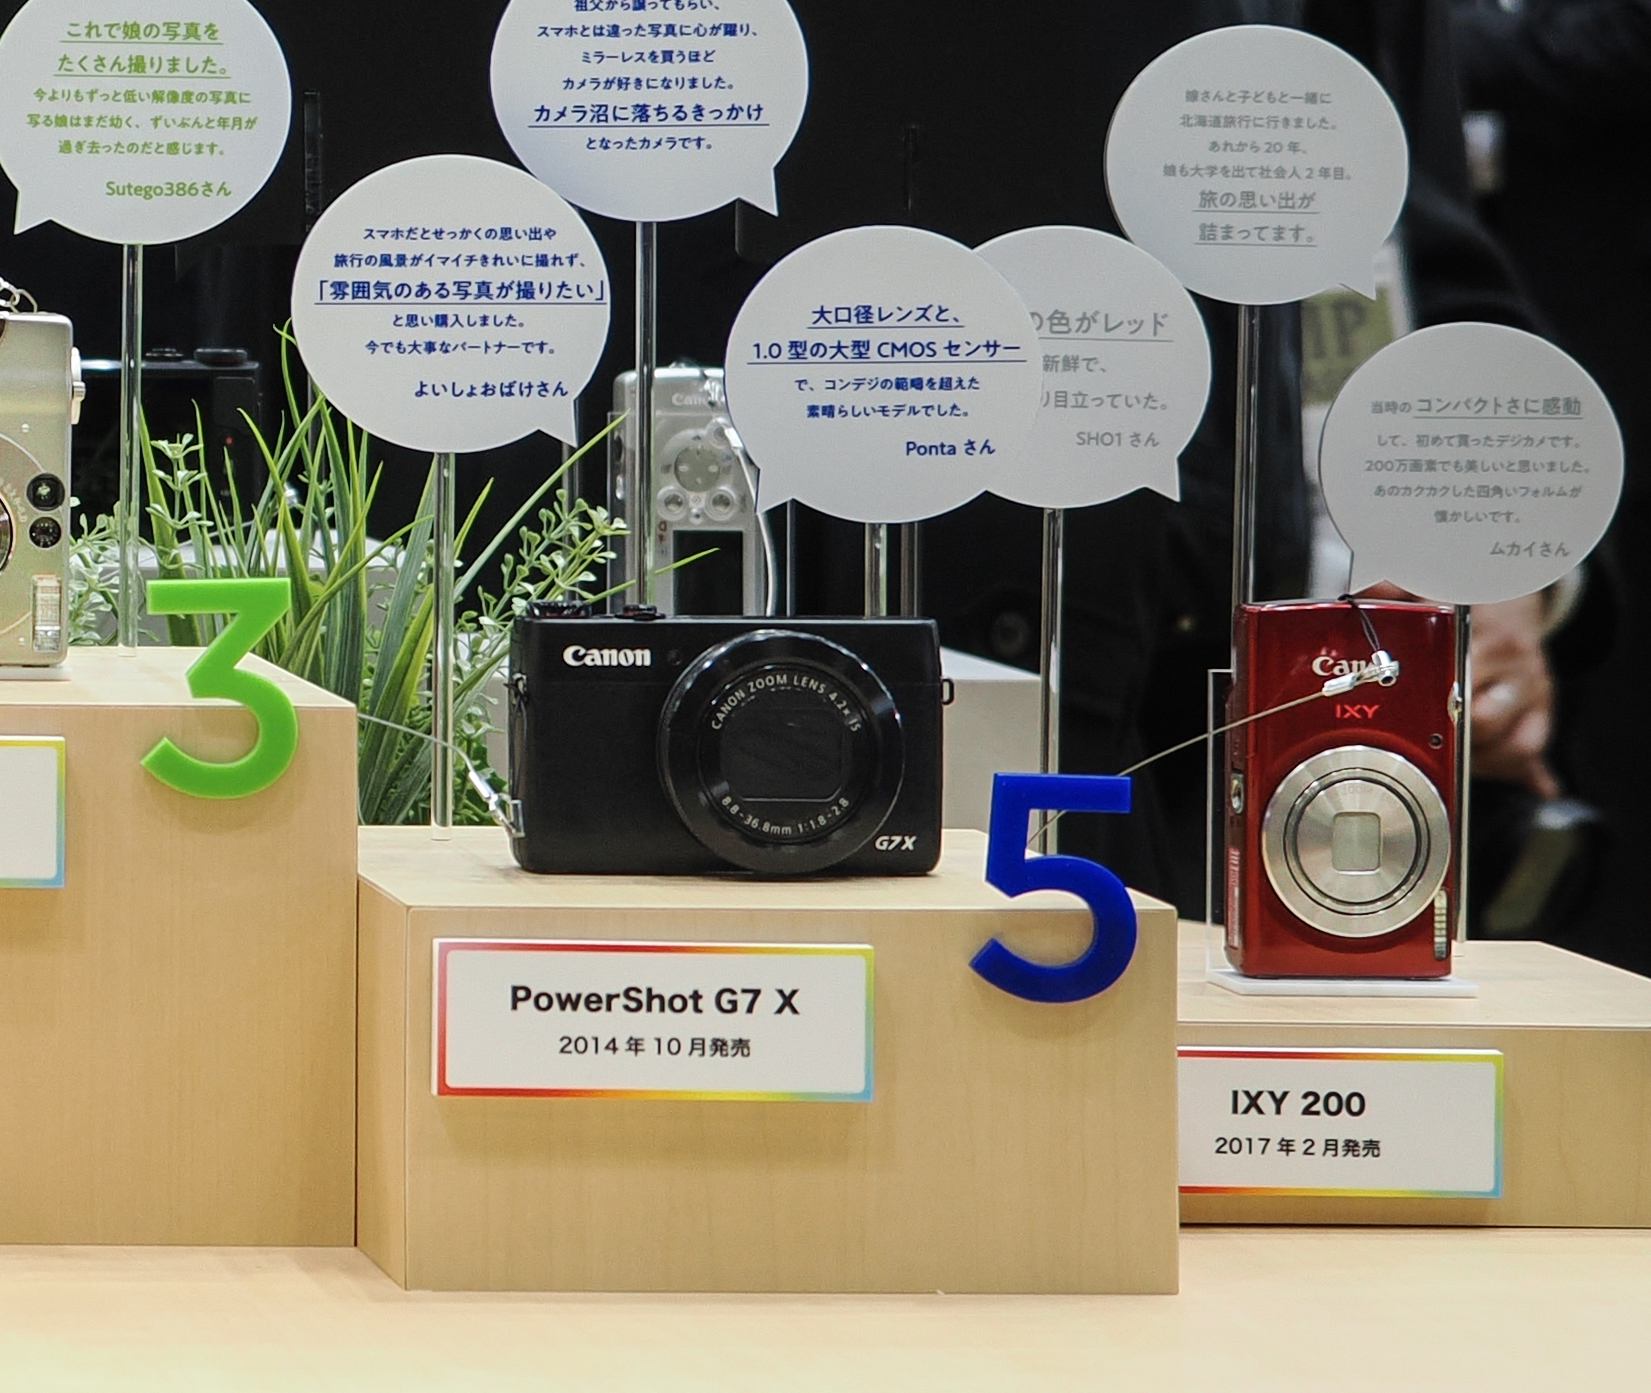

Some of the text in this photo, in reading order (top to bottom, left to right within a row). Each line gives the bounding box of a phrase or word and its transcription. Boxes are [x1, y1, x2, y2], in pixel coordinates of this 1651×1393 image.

[64, 21, 218, 42] これで娘の写真を
[55, 54, 226, 76] たくさん撮りました。
[582, 50, 715, 64] ミラーレスを買うほど
[587, 136, 711, 150] となったカメラです。
[393, 314, 523, 327] と思い購入しました。
[812, 305, 958, 324] 大口径レンズと、
[754, 340, 1020, 359] 1.0 型の大型 CMOS センサー
[415, 381, 568, 397] よいしょおばけさん
[906, 439, 995, 455] Ponta さん
[1130, 432, 1159, 448] さん
[1490, 541, 1570, 557] ムカイさん
[563, 645, 651, 668] Canon
[139, 578, 297, 798] 3
[712, 690, 745, 730] CANON
[748, 674, 787, 693] ZOOM
[794, 676, 827, 694] LENS
[848, 718, 861, 732] IS
[1335, 705, 1380, 719] IXY
[968, 772, 1138, 1002] 5
[512, 986, 799, 1014] PowerShot G7 X
[1232, 1090, 1365, 1116] IXY 200
